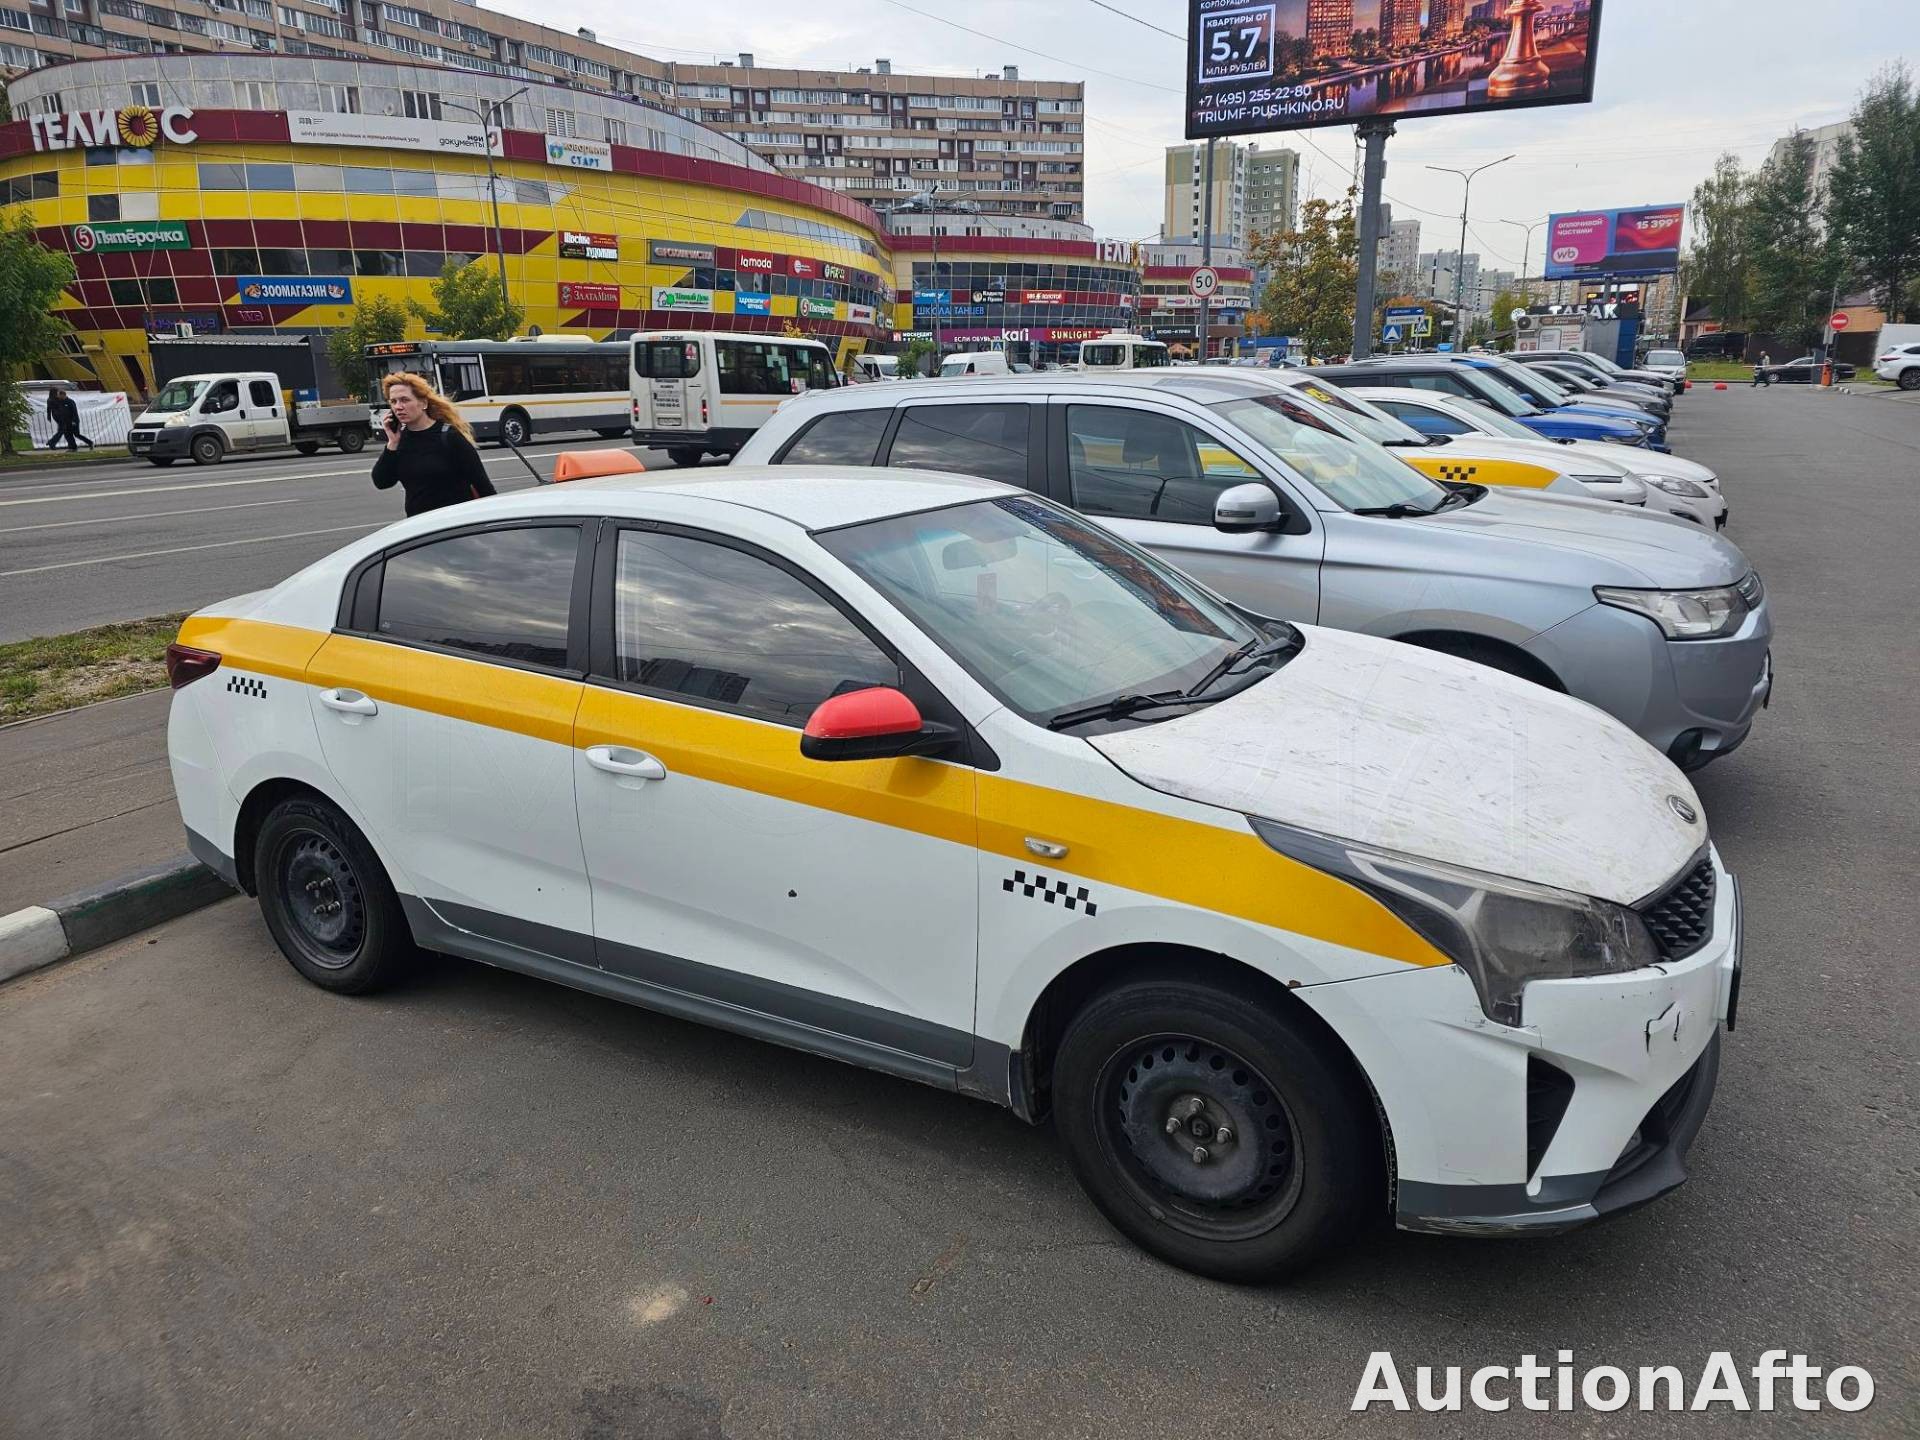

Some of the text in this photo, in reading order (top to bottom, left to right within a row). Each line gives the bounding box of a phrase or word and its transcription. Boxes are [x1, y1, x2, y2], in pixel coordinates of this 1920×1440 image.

[1206, 12, 1268, 28] КВАРТИРЫ ОТ
[1210, 27, 1262, 61] 5.7
[1206, 59, 1267, 76] МЛН РУБЛЕЙ
[1199, 84, 1312, 107] +7 (495) 255-22-80
[1199, 97, 1344, 123] TRIUMF-PUSHKINO.RU
[571, 155, 600, 167] СТАРТ
[95, 229, 184, 249] Пятёрочка
[741, 254, 772, 268] lamoda
[1196, 275, 1212, 289] 50
[262, 284, 327, 298] ЗООМАГАЗИН
[917, 306, 984, 315] ШКОЛА ТАНЦЕВ
[1548, 303, 1618, 319] ТАБАК
[1002, 328, 1028, 341] kari
[1052, 330, 1092, 339] SUNLIGHT
